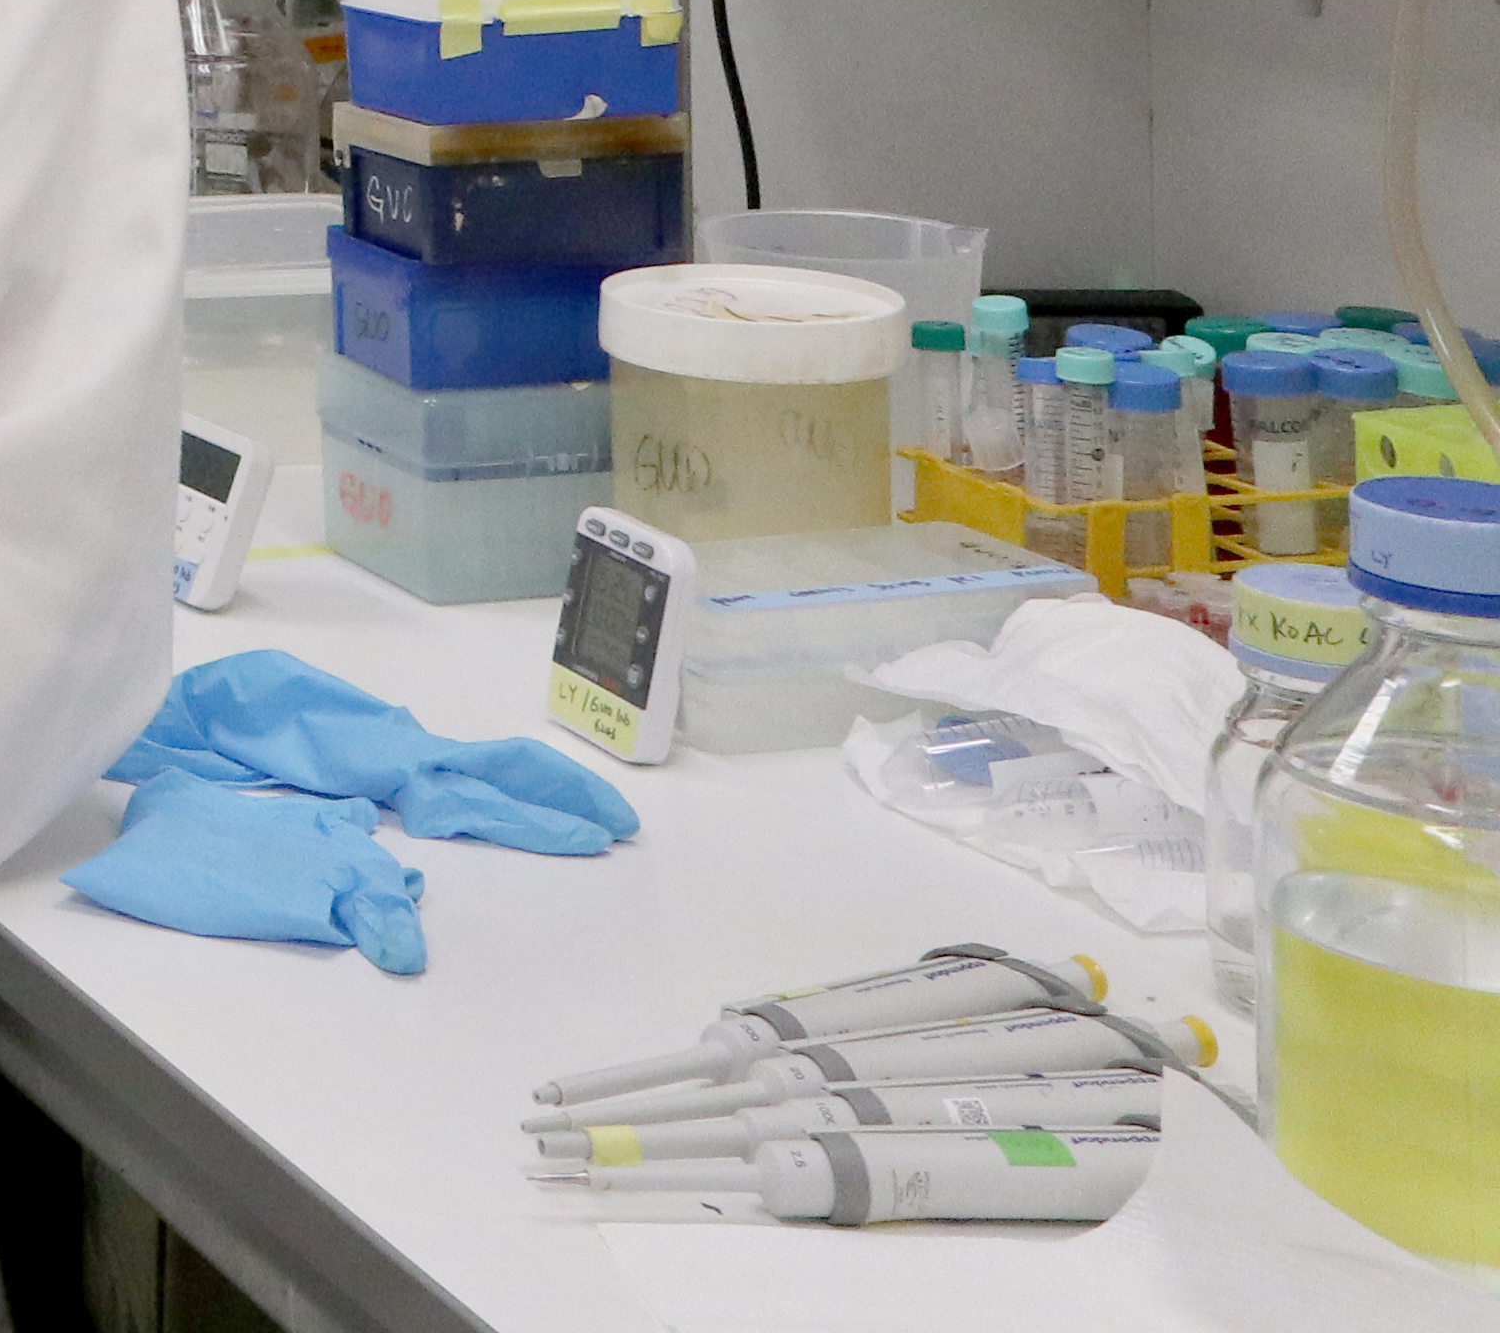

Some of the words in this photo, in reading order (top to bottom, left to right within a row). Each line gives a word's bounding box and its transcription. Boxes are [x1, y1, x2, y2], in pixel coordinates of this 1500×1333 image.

[926, 960, 987, 981] eppendorf
[739, 1021, 760, 1043] 200
[1002, 1015, 1078, 1034] eppendorf
[788, 1064, 806, 1082] 20
[1073, 1076, 1158, 1089] eppendorf
[1069, 1134, 1162, 1147] eppendorf
